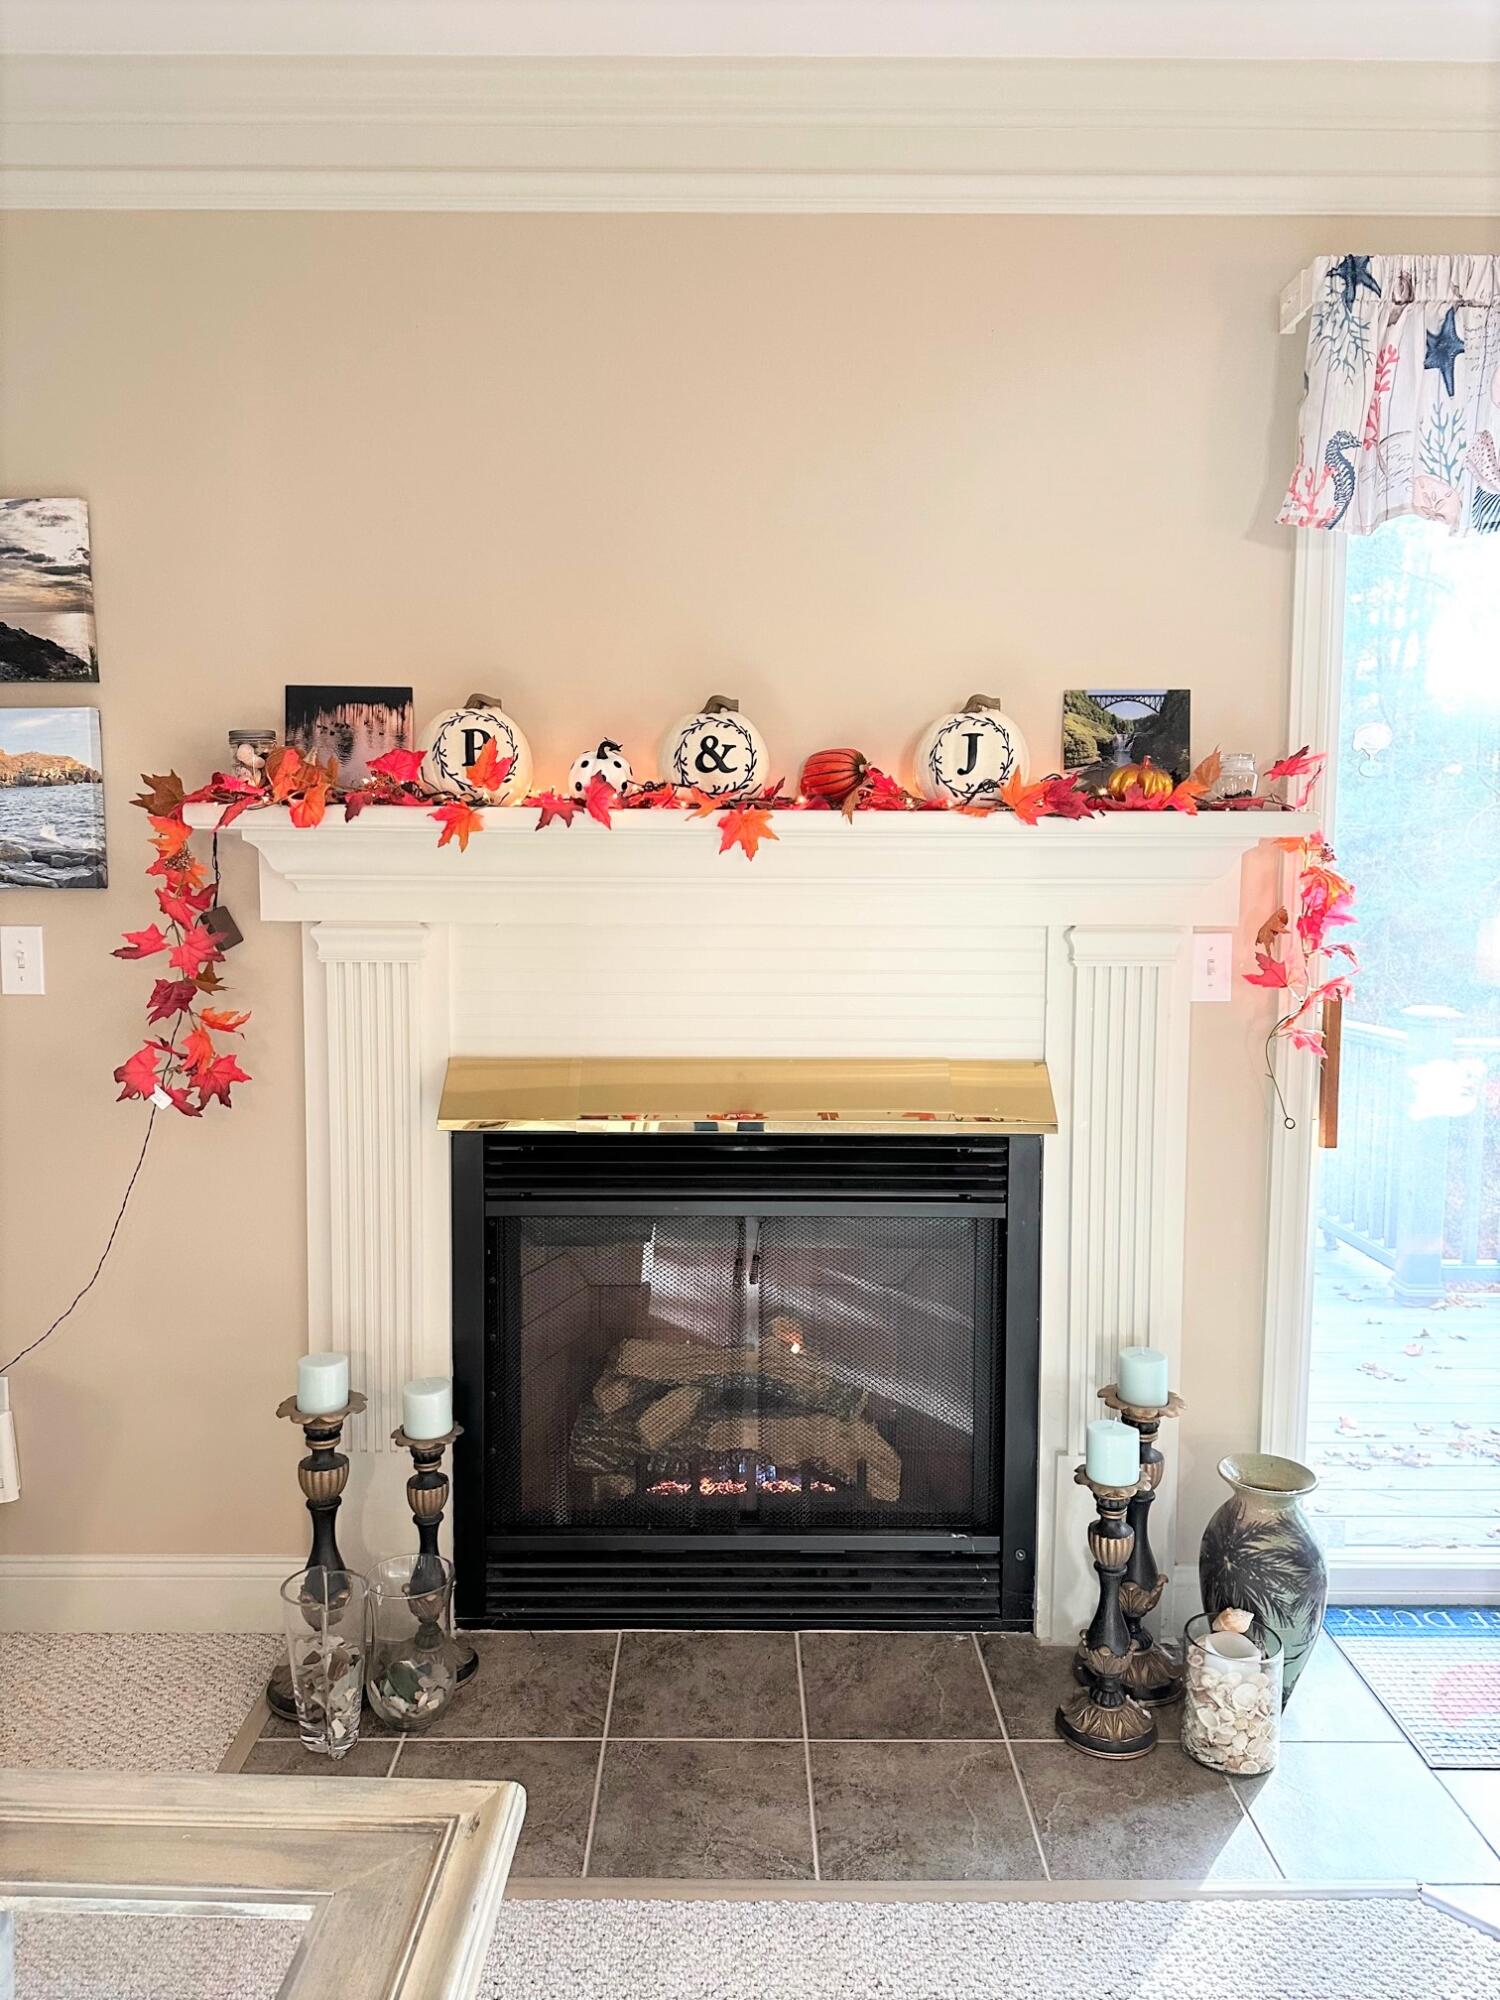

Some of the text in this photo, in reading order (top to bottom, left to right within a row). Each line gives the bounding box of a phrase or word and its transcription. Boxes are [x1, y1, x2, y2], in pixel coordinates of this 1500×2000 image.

[461, 728, 984, 775] P & J
[1338, 1609, 1459, 1629] DUTY
